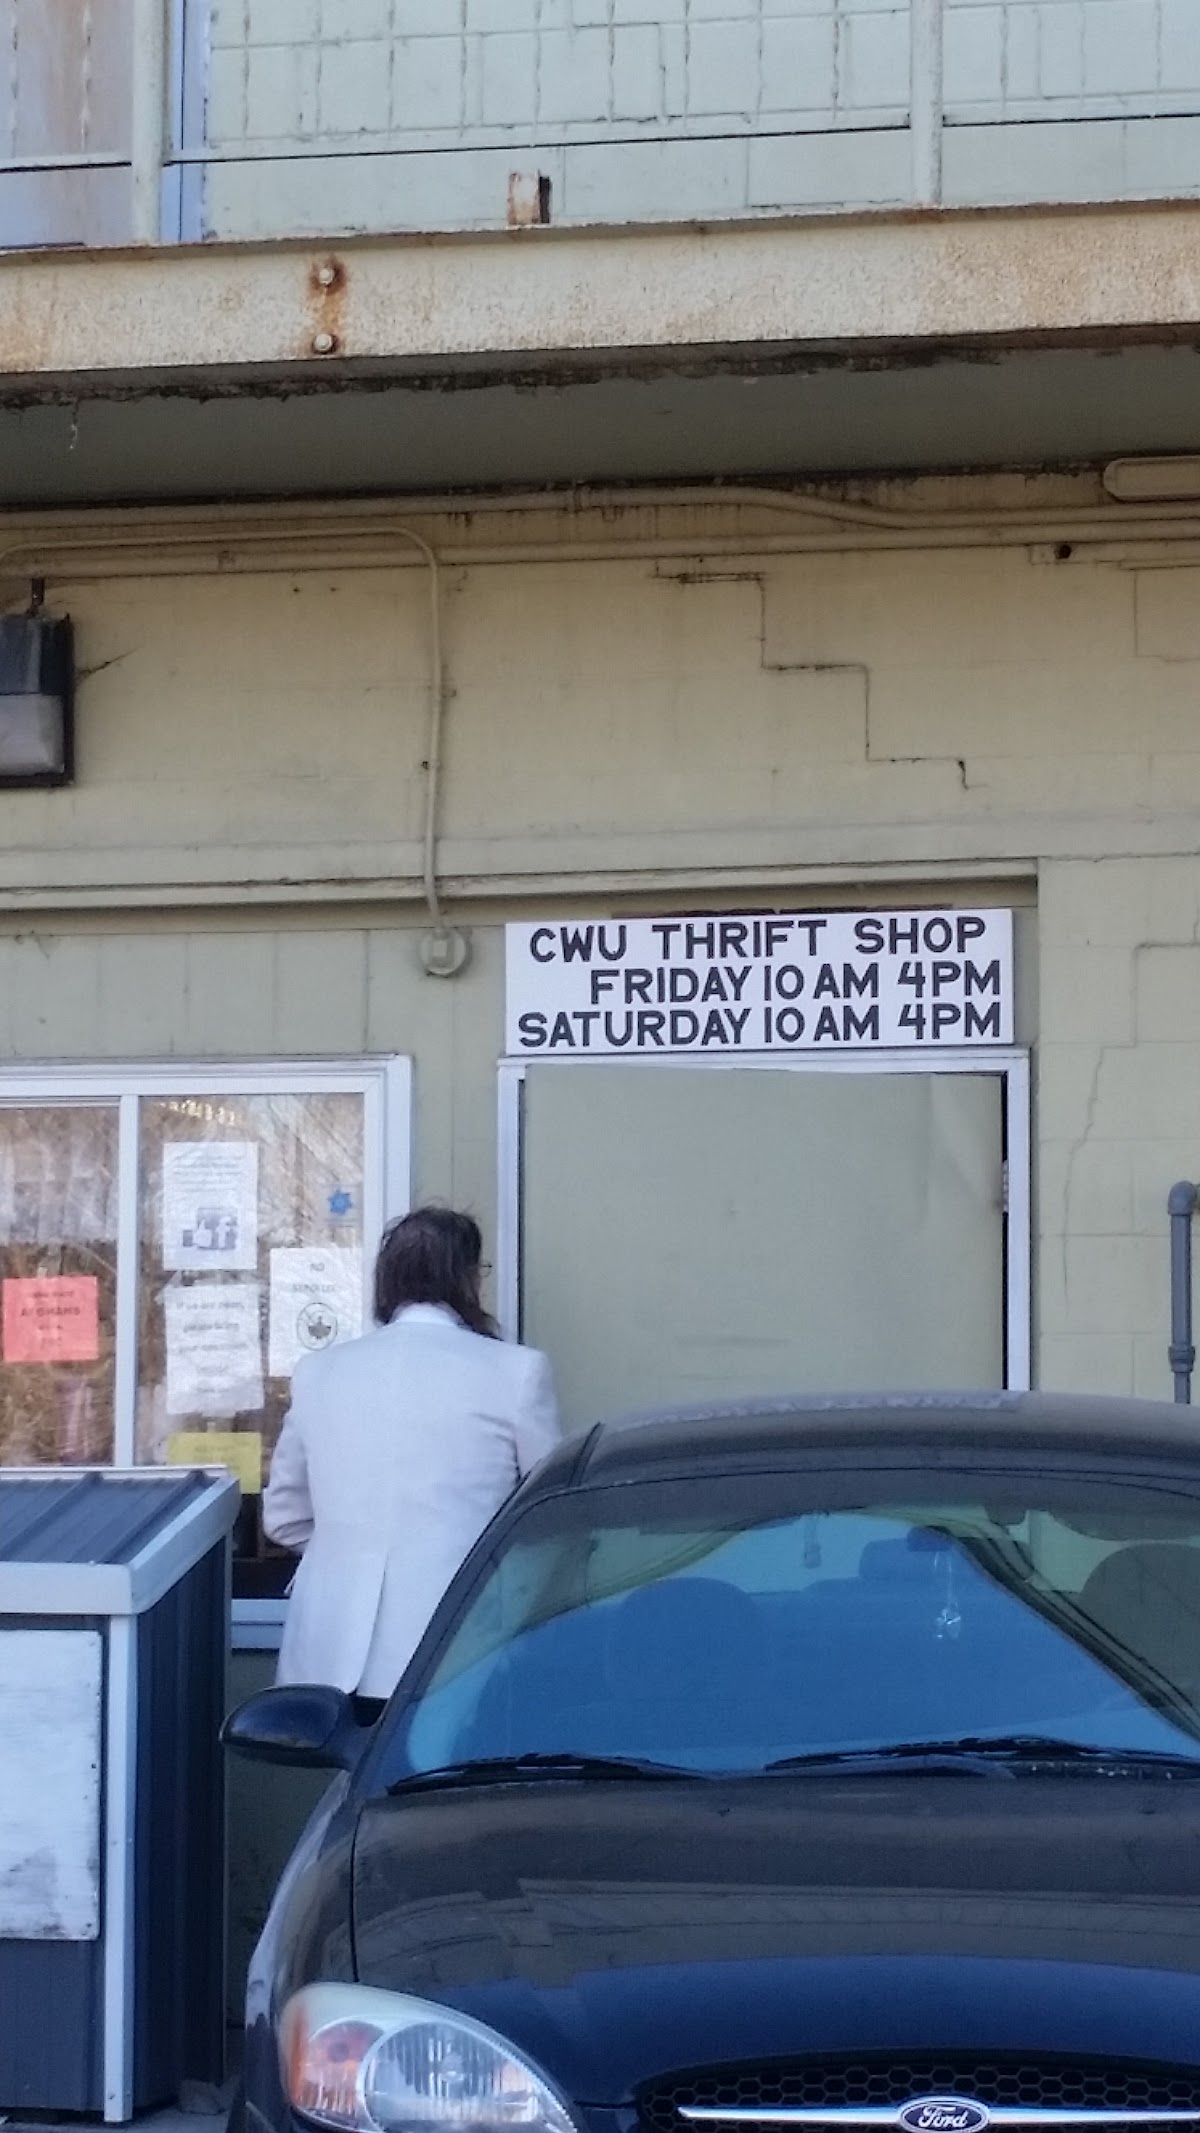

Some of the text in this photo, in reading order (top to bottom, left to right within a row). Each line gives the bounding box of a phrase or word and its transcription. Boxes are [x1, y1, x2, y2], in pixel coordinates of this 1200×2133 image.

[529, 915, 987, 963] CWU THRIFT SHOP
[590, 964, 753, 1006] FRIDAY
[897, 959, 1001, 999] 4PM
[518, 1007, 752, 1048] SATURDAY
[897, 1001, 1001, 1040] 4PM
[918, 2106, 969, 2128] Ford
